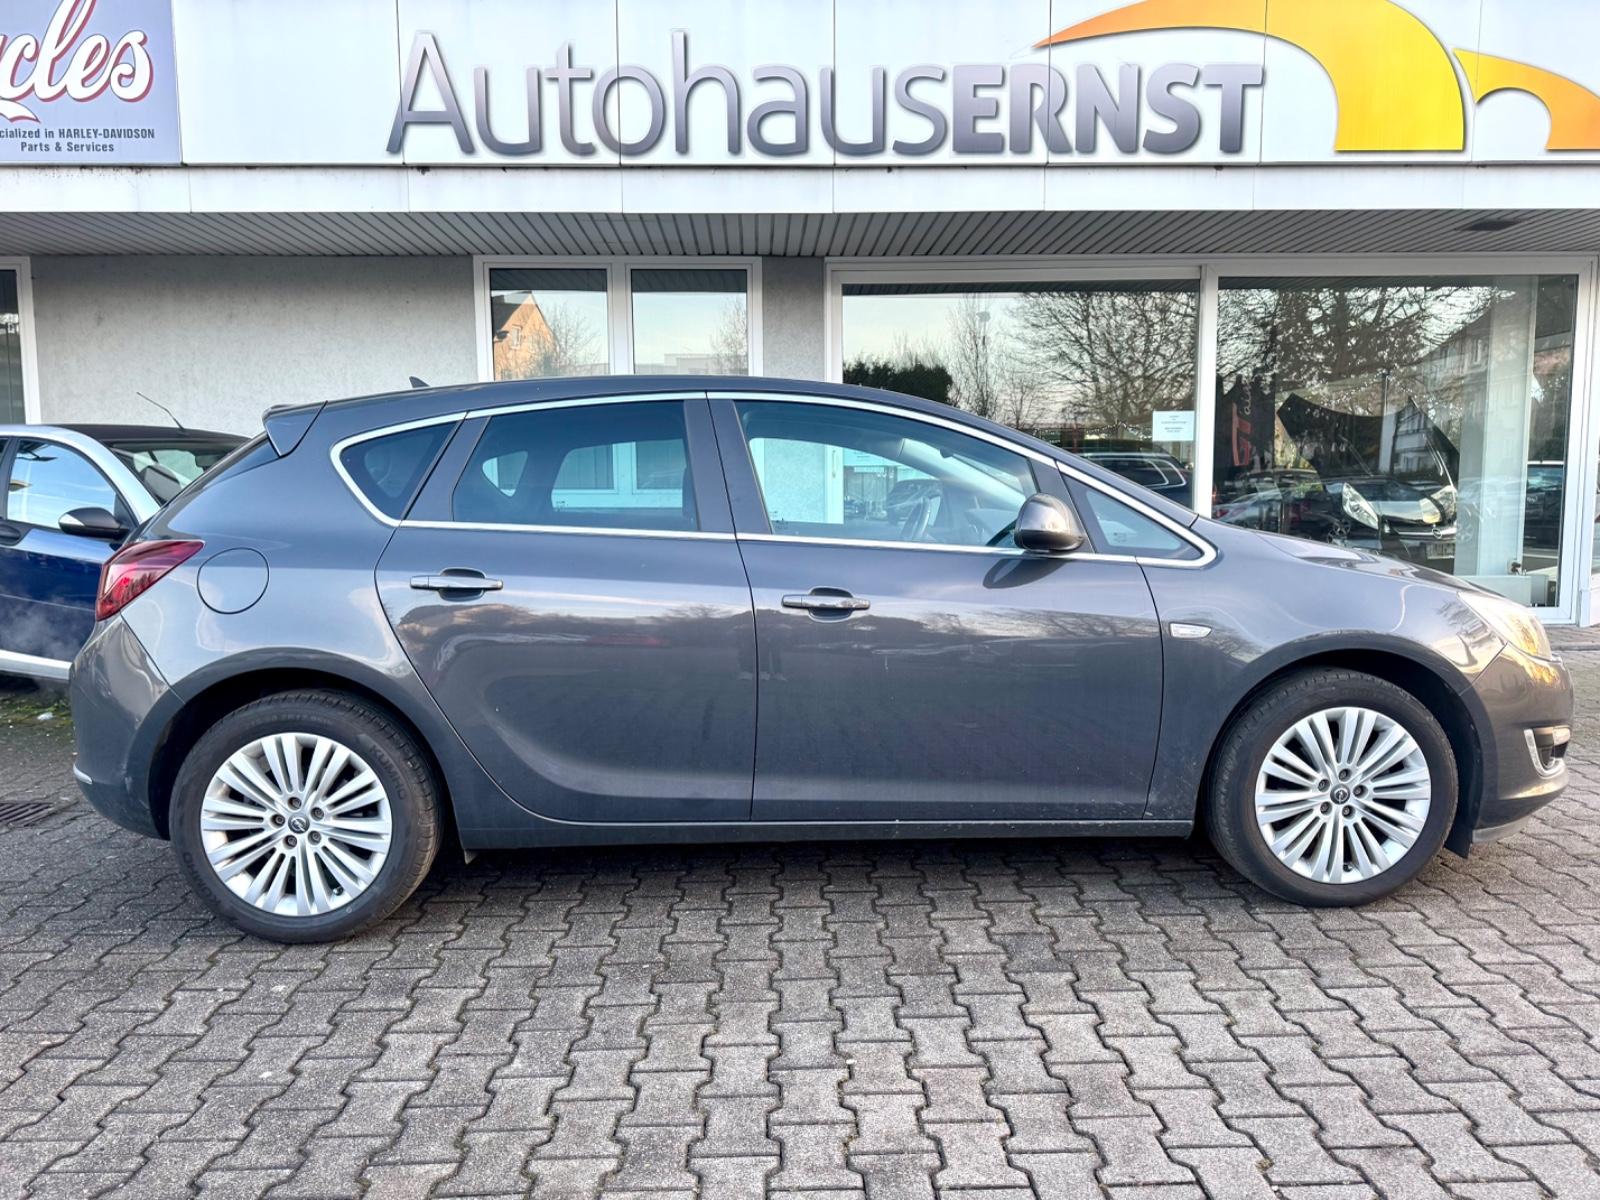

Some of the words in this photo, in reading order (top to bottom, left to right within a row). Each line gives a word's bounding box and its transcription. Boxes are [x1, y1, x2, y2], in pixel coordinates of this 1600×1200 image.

[0, 0, 154, 103] cles
[44, 128, 55, 139] in
[58, 128, 155, 139] HARLEY-DAVIDSON
[20, 142, 50, 152] Parts
[54, 141, 62, 152] &
[66, 141, 115, 152] Services
